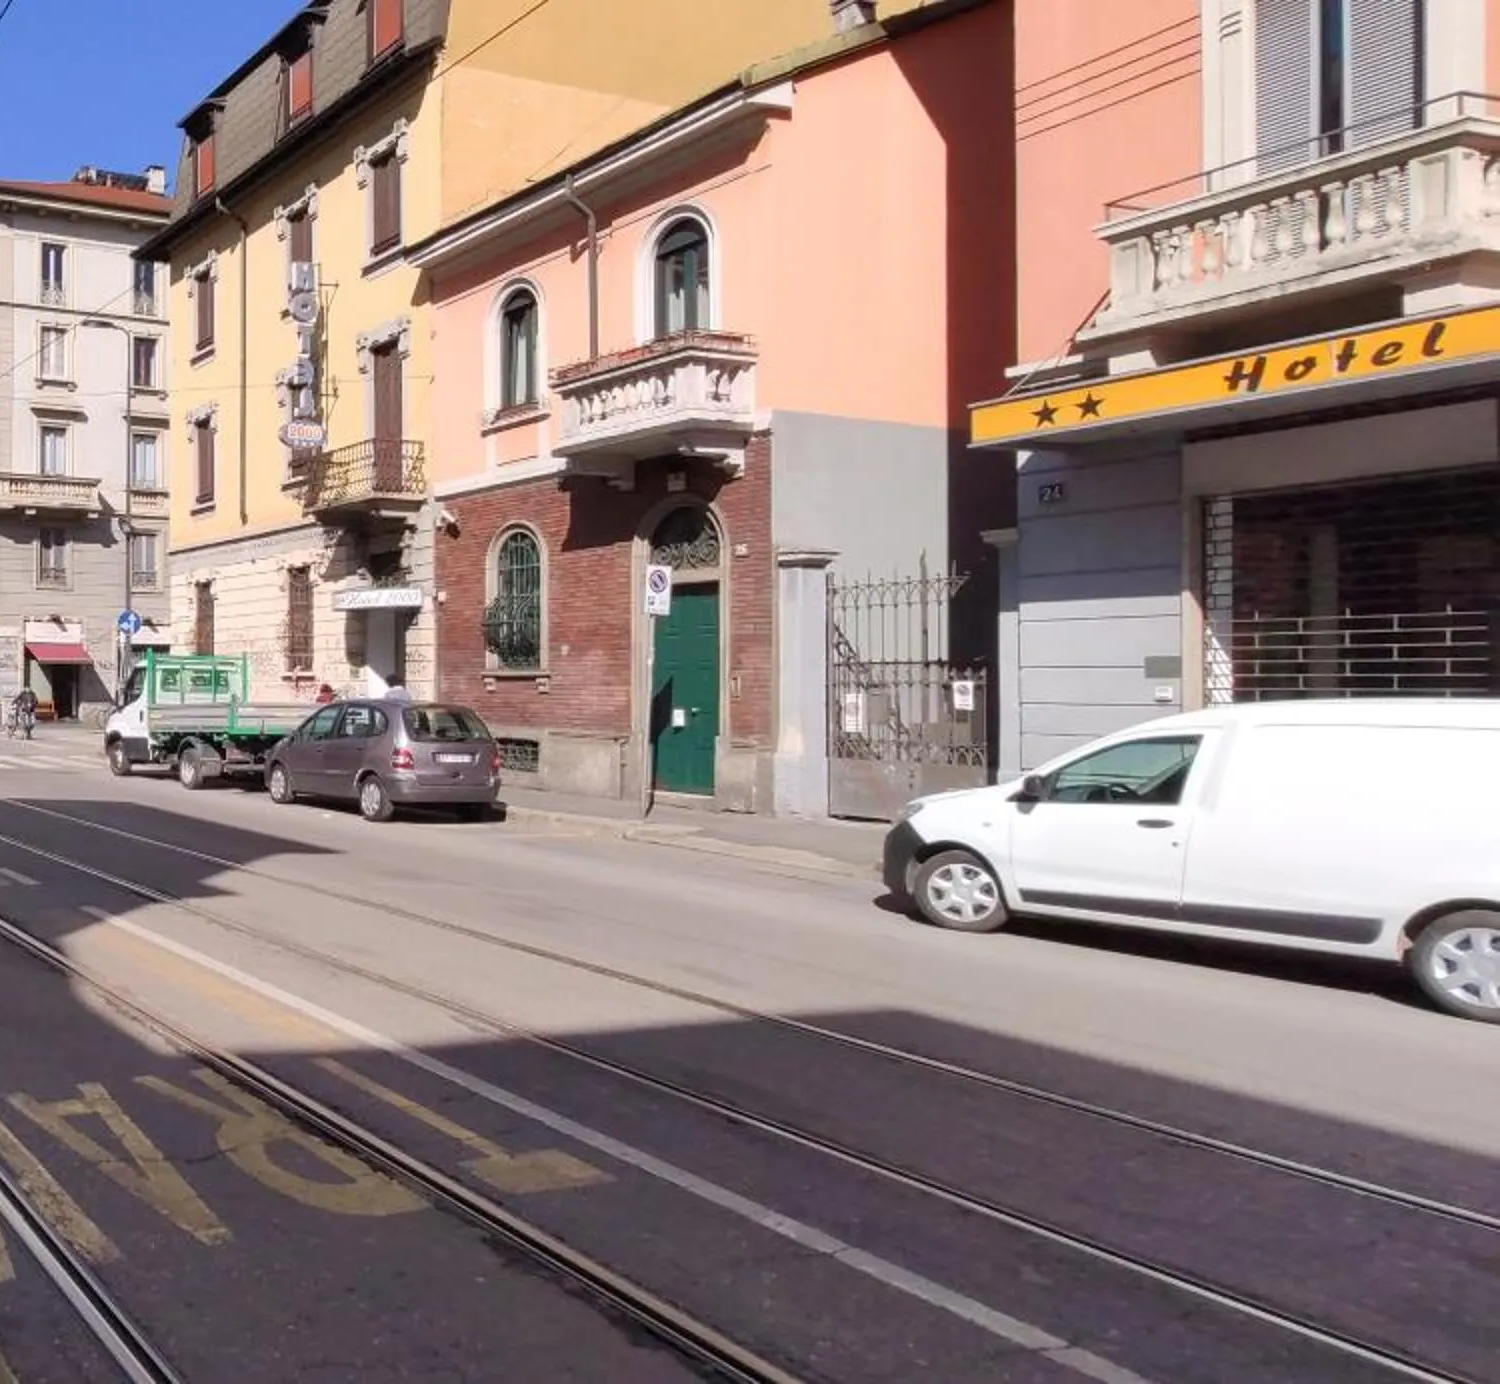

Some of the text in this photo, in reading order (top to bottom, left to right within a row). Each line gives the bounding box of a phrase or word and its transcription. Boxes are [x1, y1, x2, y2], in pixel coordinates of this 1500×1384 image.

[1223, 321, 1447, 393] Hotel
[289, 424, 324, 440] 2000
[1041, 485, 1061, 501] 24
